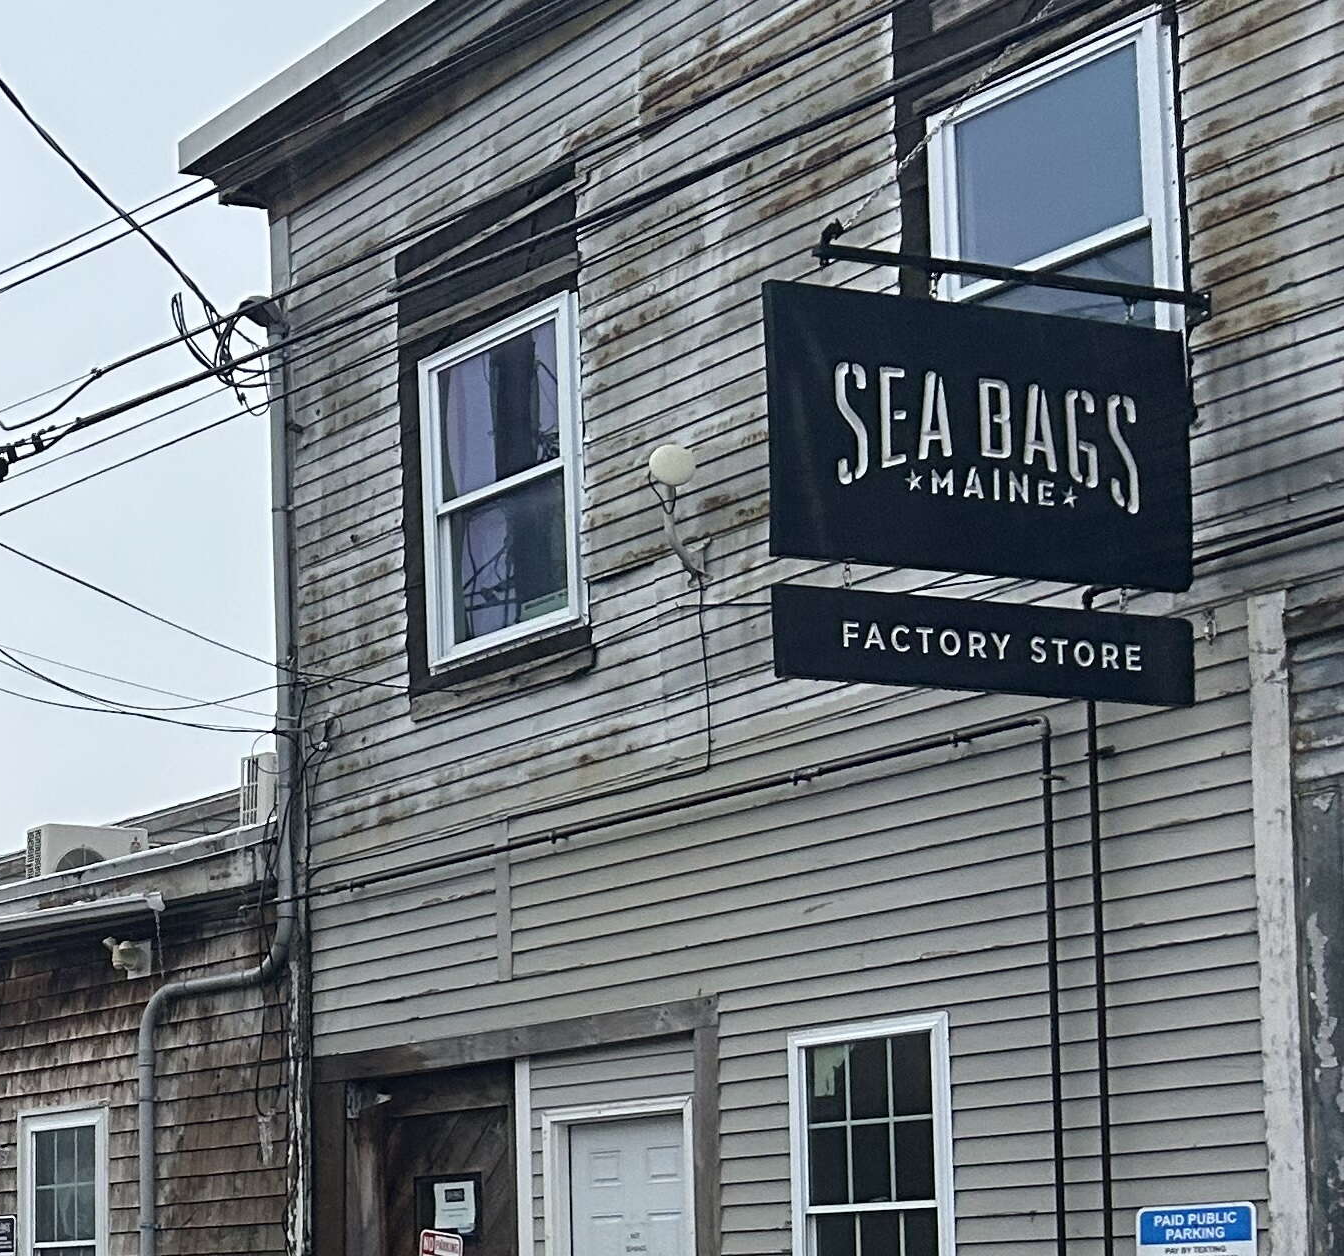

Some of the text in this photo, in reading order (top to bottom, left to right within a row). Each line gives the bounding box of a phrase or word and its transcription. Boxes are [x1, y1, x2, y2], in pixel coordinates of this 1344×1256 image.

[834, 361, 1141, 516] SEA BAGS
[930, 468, 1056, 507] MAINE
[841, 621, 1143, 672] FACTORY STORE
[1153, 1211, 1237, 1227] PAID PUBLIC
[1165, 1226, 1226, 1241] PARKING
